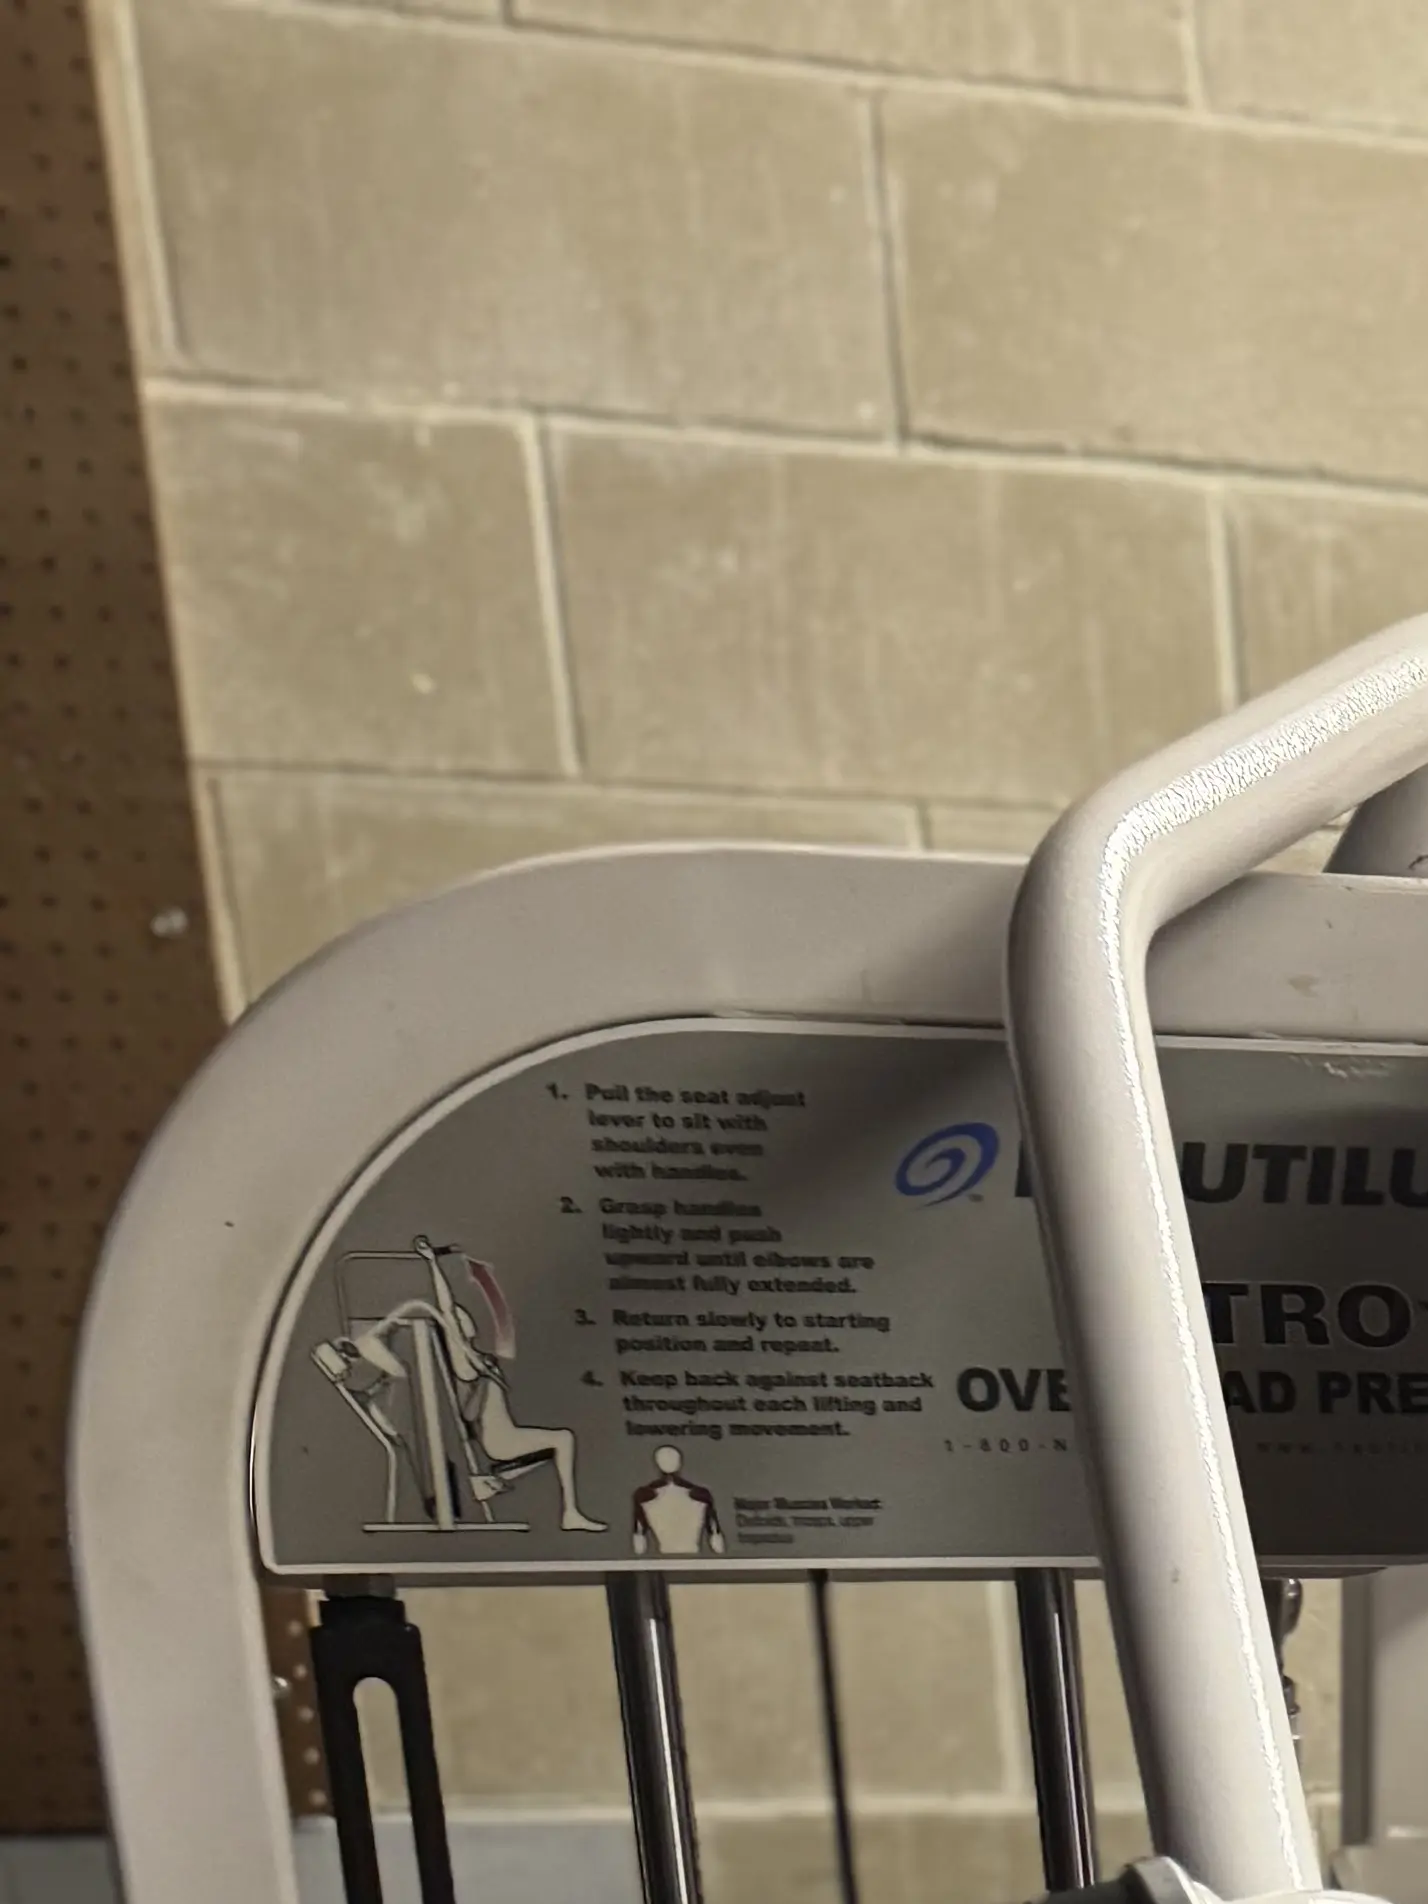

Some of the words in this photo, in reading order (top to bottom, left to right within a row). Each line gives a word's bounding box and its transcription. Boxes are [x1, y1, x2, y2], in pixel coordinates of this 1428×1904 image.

[546, 1083, 569, 1100] 1.
[585, 1083, 629, 1102] Pull
[635, 1086, 673, 1103] the
[679, 1089, 729, 1105] seat
[587, 1109, 644, 1127] lever
[652, 1111, 674, 1129] to
[681, 1113, 711, 1129] sit
[717, 1114, 767, 1131] with
[591, 1136, 705, 1154] shoulders
[594, 1161, 645, 1179] with
[560, 1196, 582, 1213] 2.
[599, 1198, 667, 1218] Grasp
[602, 1223, 673, 1244] lightly
[680, 1225, 721, 1241] and
[728, 1226, 782, 1245] push
[697, 1251, 746, 1267] until
[753, 1253, 831, 1269] elbows
[837, 1256, 875, 1270] are
[693, 1275, 741, 1295] fully
[747, 1277, 857, 1294] extended.
[574, 1309, 596, 1326] 3.
[612, 1309, 690, 1327] Return
[696, 1311, 767, 1332] slowly
[774, 1313, 798, 1328] to
[803, 1313, 891, 1333] starting
[1201, 1282, 1412, 1348] TRO
[615, 1336, 707, 1355] position
[713, 1337, 753, 1352] and
[760, 1338, 840, 1355] repeat.
[581, 1370, 603, 1387] 4.
[620, 1370, 678, 1390] Keep
[685, 1371, 739, 1388] back
[746, 1372, 828, 1390] against
[834, 1373, 934, 1389] seatback
[957, 1367, 1298, 1413] OVEAD
[623, 1397, 747, 1415] throughout
[754, 1398, 807, 1412] each
[813, 1398, 877, 1415] lifting
[883, 1398, 923, 1412] and
[626, 1421, 723, 1440] lowering
[729, 1422, 851, 1437] movement.
